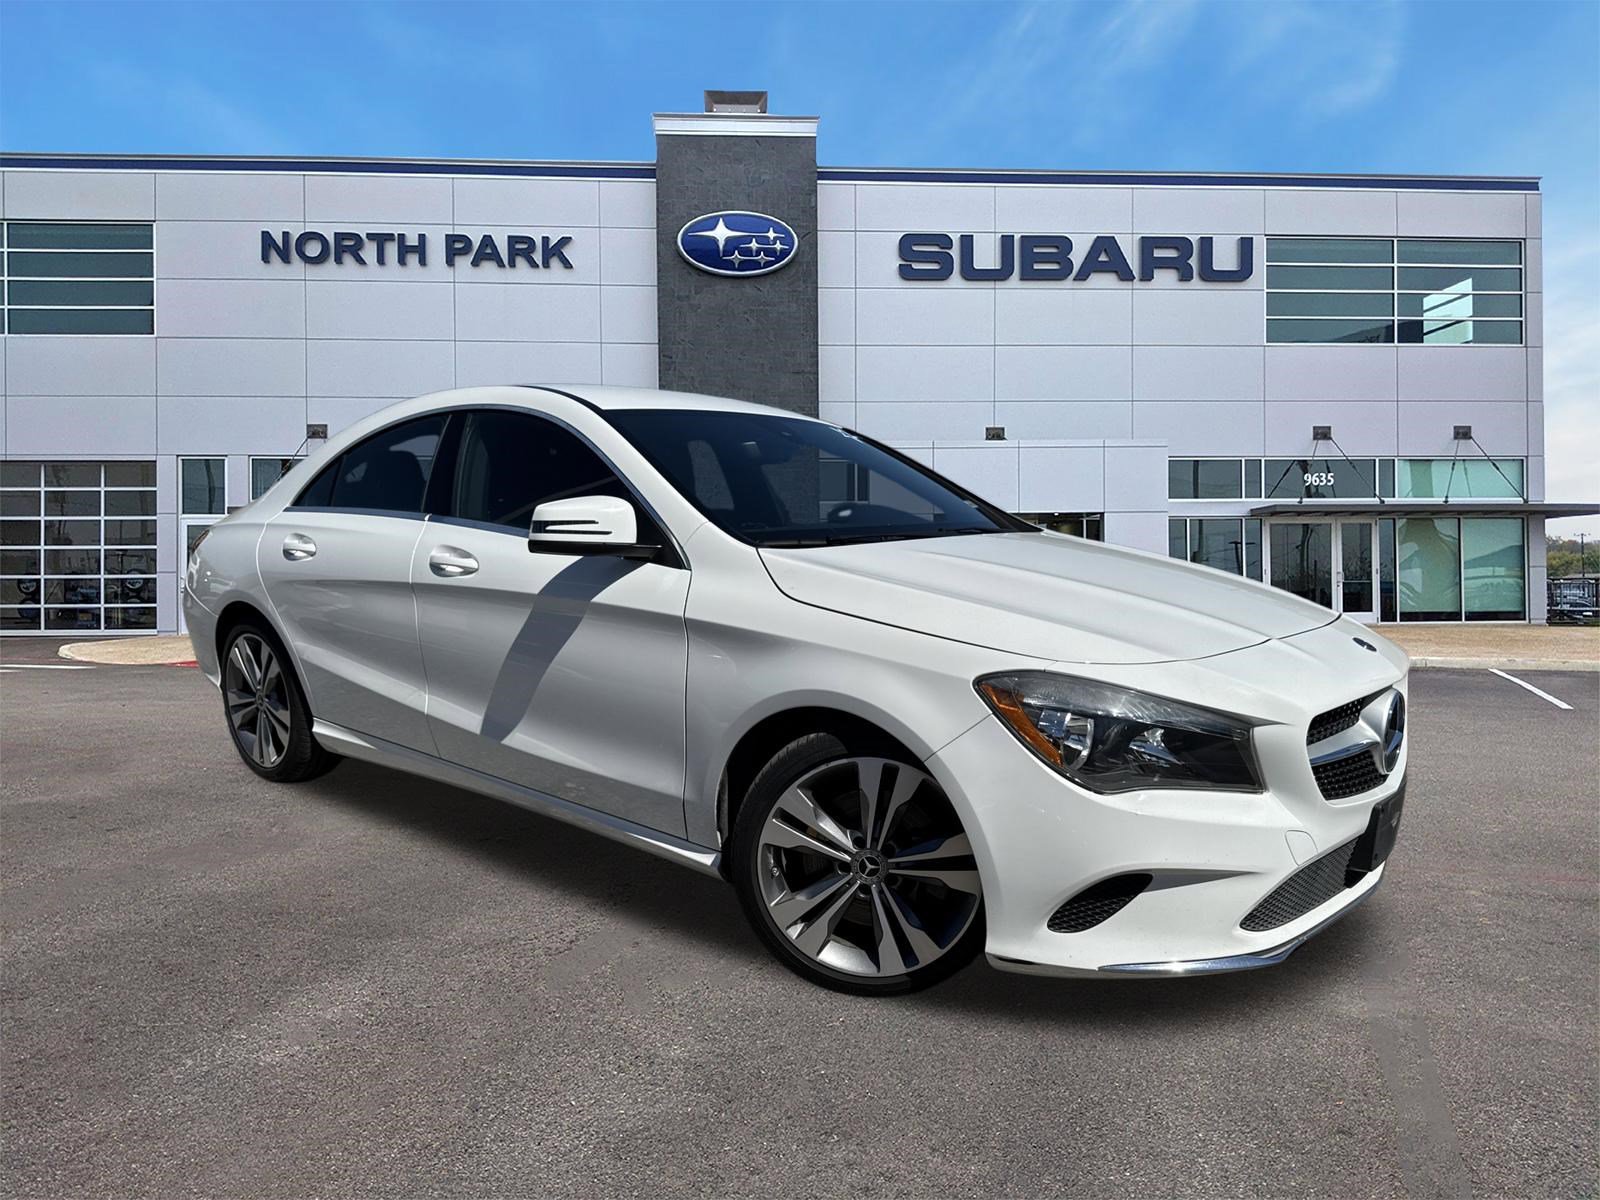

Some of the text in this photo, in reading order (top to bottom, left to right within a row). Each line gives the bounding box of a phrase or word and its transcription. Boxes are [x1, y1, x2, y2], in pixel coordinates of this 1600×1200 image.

[261, 230, 574, 269] NORTH PARK
[898, 233, 1254, 282] SUBARU
[1304, 472, 1335, 486] 9635
